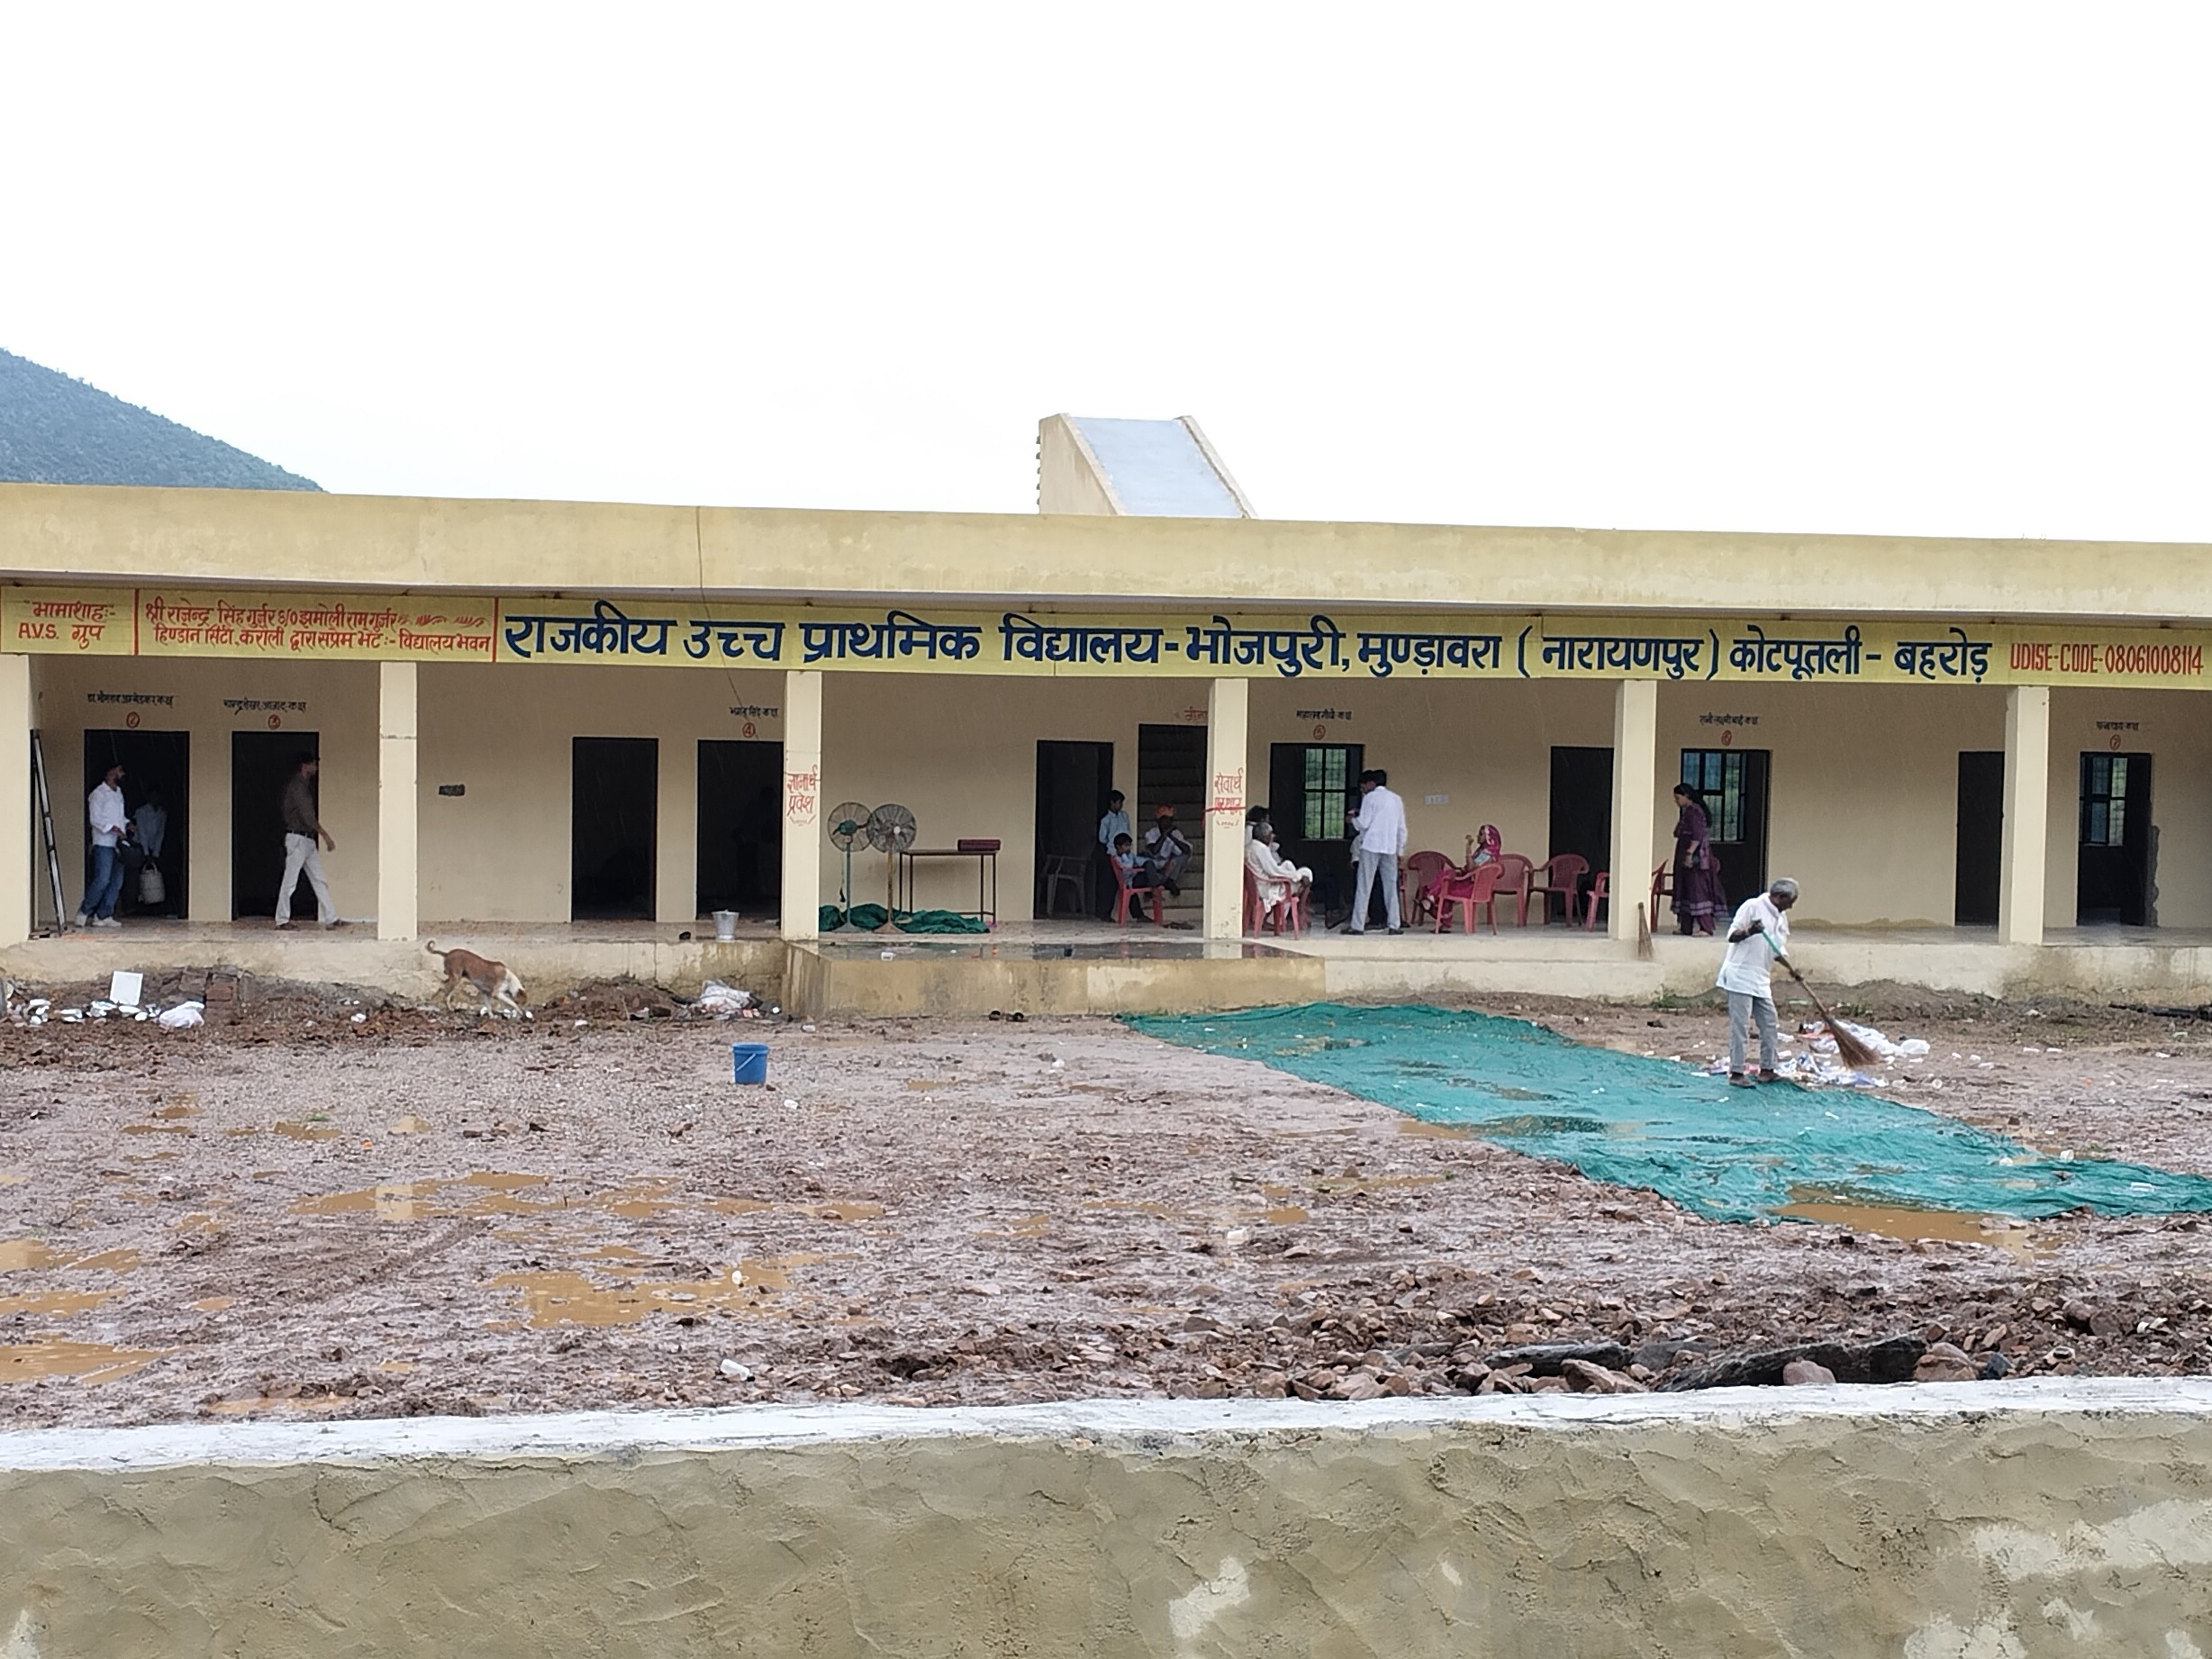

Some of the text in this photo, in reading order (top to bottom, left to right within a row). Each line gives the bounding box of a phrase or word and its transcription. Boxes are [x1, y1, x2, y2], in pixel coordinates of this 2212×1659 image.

[145, 595, 166, 623] श्री
[168, 596, 214, 626] राजेन्द्र
[217, 598, 246, 626] सिंह
[71, 624, 105, 649] ग्रुप
[290, 630, 317, 651] द्वारा
[399, 628, 455, 655] विद्यालय
[457, 633, 491, 652] भवन
[504, 599, 677, 658] राजकीय
[684, 620, 786, 661] उच्च
[799, 610, 983, 663] प्राथमिक
[1894, 627, 1992, 683] बहरोड़
[1214, 766, 1244, 793] सेवार्थ
[787, 793, 815, 817] प्रवेश
